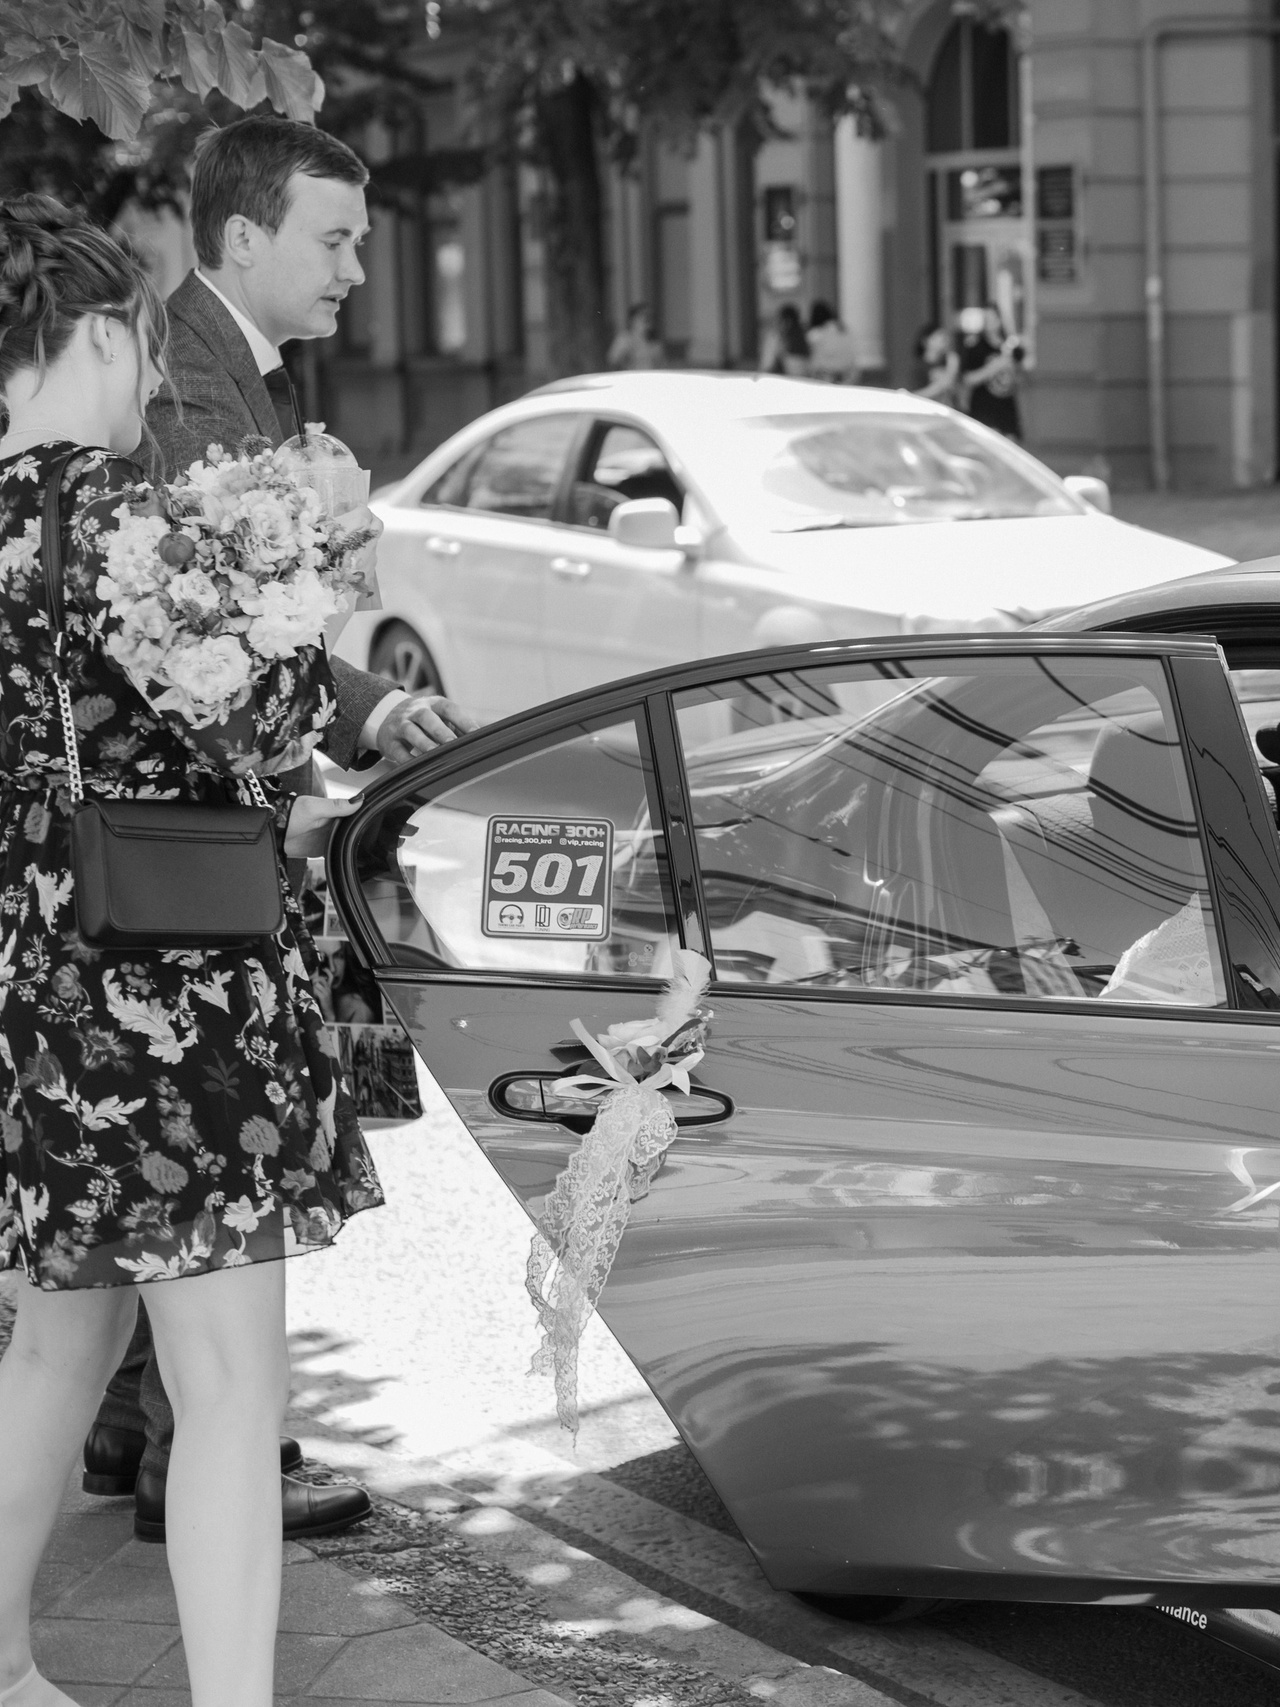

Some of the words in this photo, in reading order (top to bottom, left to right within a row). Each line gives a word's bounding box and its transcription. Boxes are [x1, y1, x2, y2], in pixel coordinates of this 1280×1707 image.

[496, 823, 560, 836] RACING
[565, 826, 605, 838] 300+
[567, 839, 604, 847] vip_racing
[491, 852, 603, 896] 501
